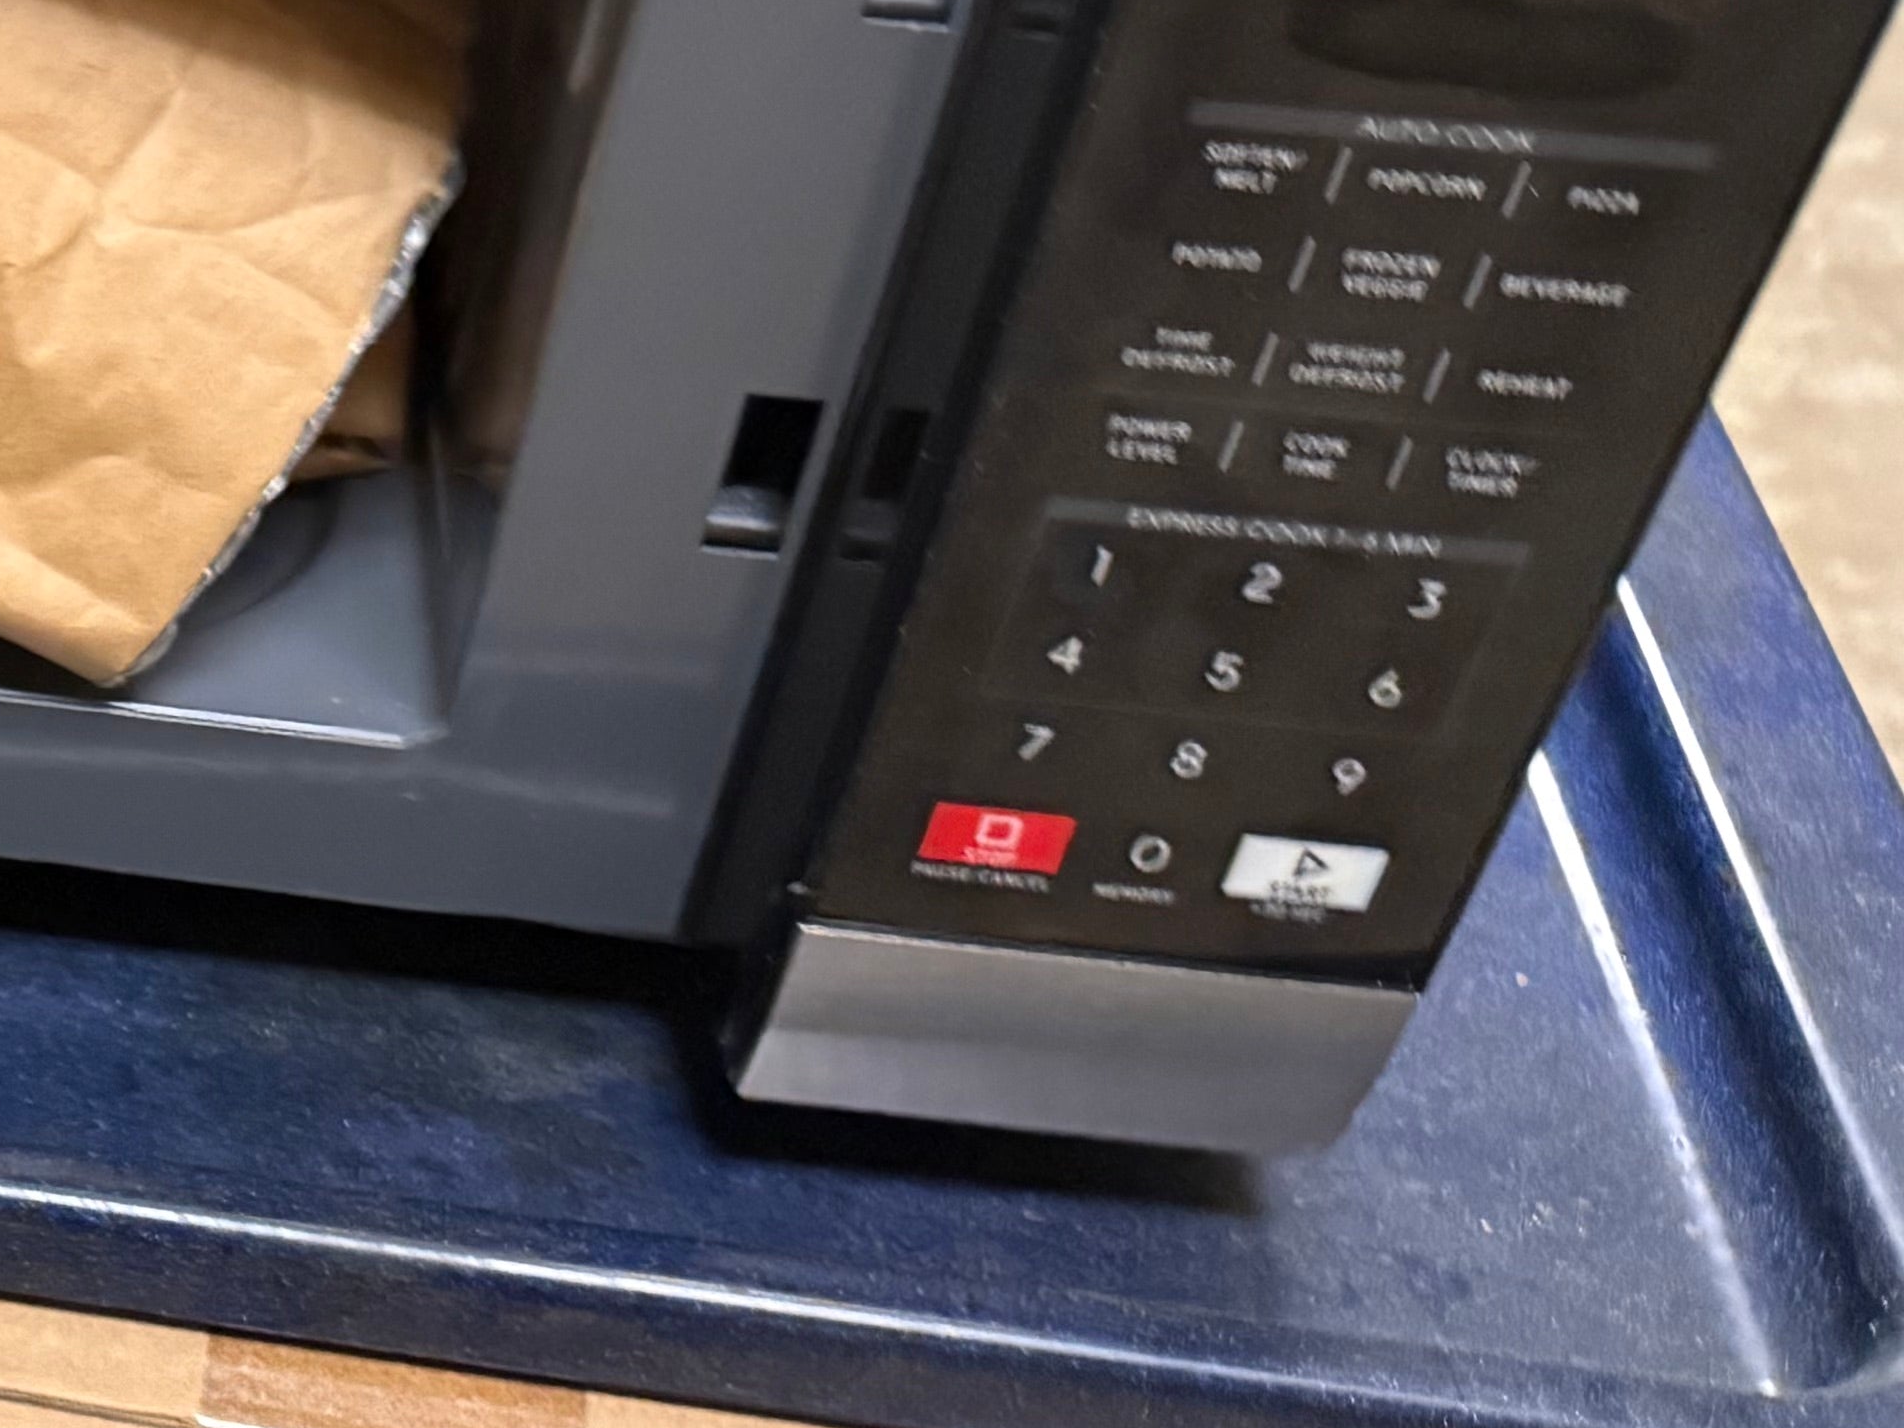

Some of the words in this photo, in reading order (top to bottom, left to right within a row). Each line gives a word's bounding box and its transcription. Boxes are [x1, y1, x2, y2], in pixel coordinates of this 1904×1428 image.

[1367, 167, 1487, 201] POPCORN
[1499, 272, 1630, 308] BEVERAGE
[1092, 545, 1113, 586] 1
[1242, 562, 1283, 604] 2
[1407, 578, 1447, 620] 3
[1047, 635, 1084, 674] 4
[1205, 651, 1244, 692] 5
[1368, 668, 1403, 709] 6
[1017, 722, 1055, 761] 7
[1169, 739, 1209, 779] 8
[1332, 757, 1367, 796] 9
[1128, 833, 1174, 875] 0
